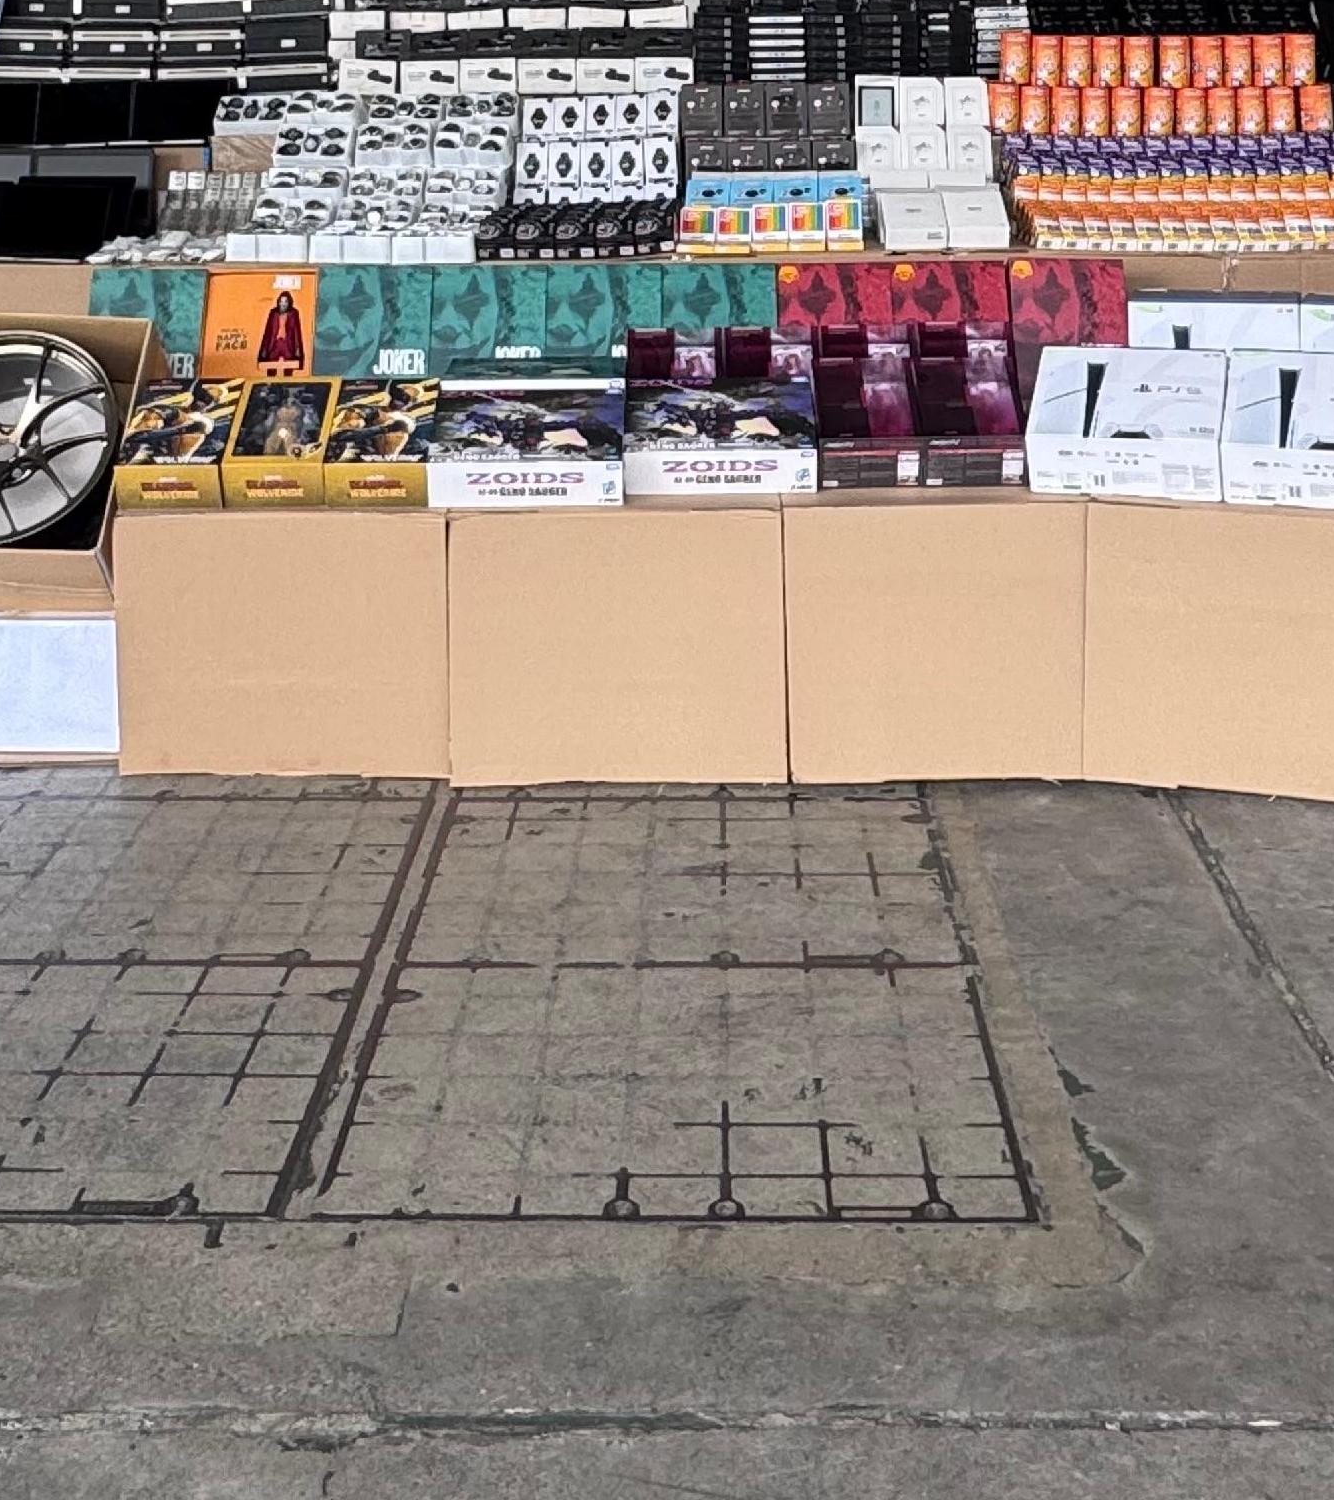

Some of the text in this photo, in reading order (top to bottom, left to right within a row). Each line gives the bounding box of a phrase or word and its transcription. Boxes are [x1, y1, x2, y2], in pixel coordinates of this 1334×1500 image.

[372, 349, 426, 376] JOKER
[662, 459, 779, 473] ZOIDS
[466, 472, 585, 486] ZOIDS
